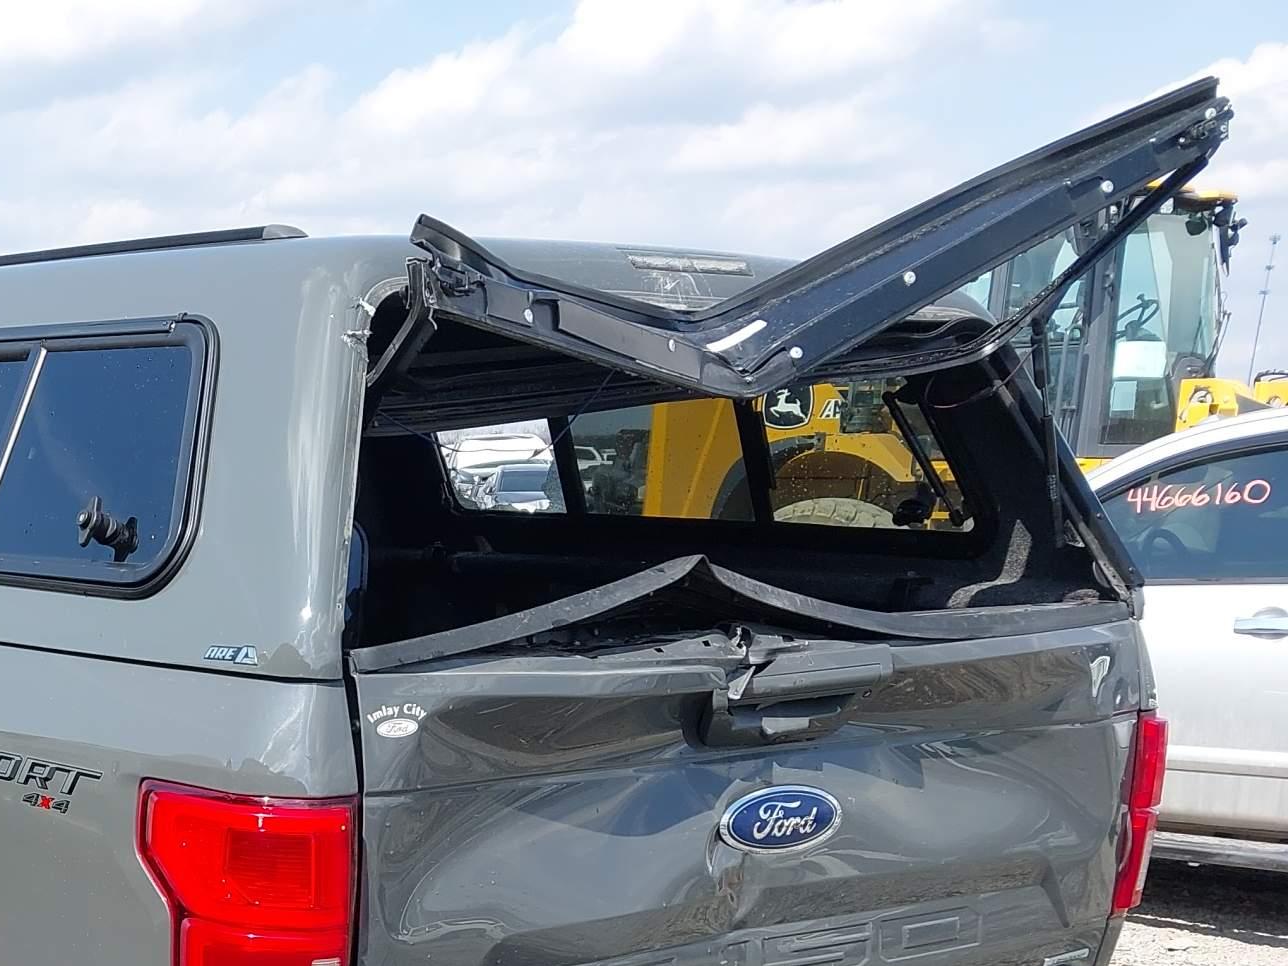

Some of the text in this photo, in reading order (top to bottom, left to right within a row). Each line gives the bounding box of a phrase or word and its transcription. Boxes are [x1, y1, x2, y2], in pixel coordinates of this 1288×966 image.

[1127, 479, 1272, 514] 44666160
[367, 703, 428, 724] Imlay City
[753, 800, 818, 840] Ford
